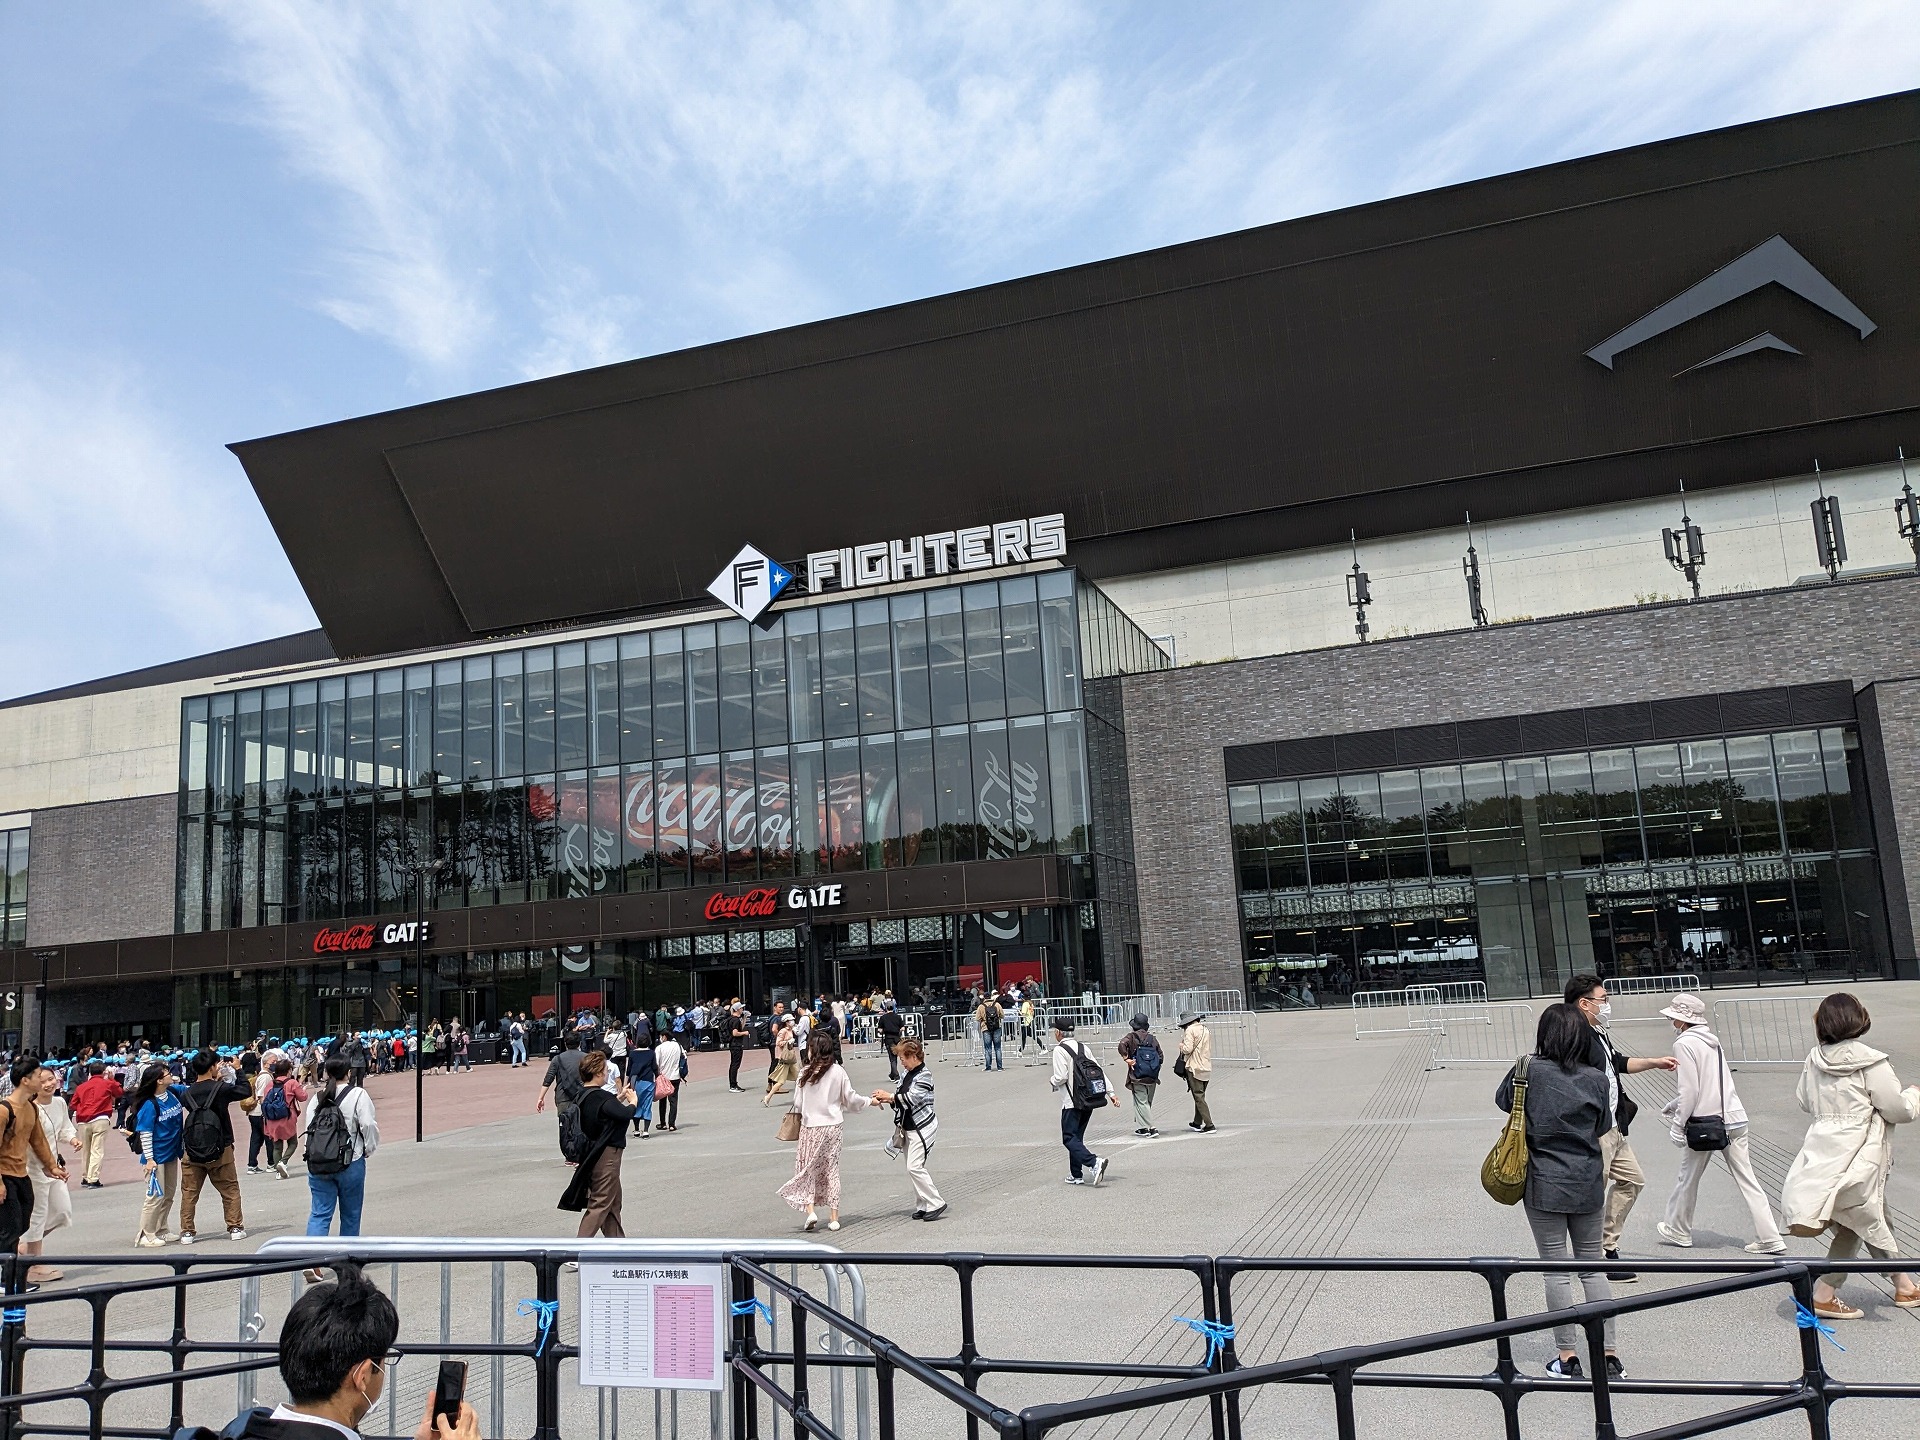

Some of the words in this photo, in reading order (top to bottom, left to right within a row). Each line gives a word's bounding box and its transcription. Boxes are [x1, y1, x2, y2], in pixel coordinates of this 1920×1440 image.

[807, 513, 1067, 593] FIGHTERS
[733, 559, 765, 609] F
[704, 888, 780, 920] Coca-Cola
[788, 884, 842, 909] GATE
[313, 924, 377, 953] Coca-Cola
[383, 921, 429, 944] GATE
[612, 1269, 689, 1280] 北広島駅行バス時刻表
